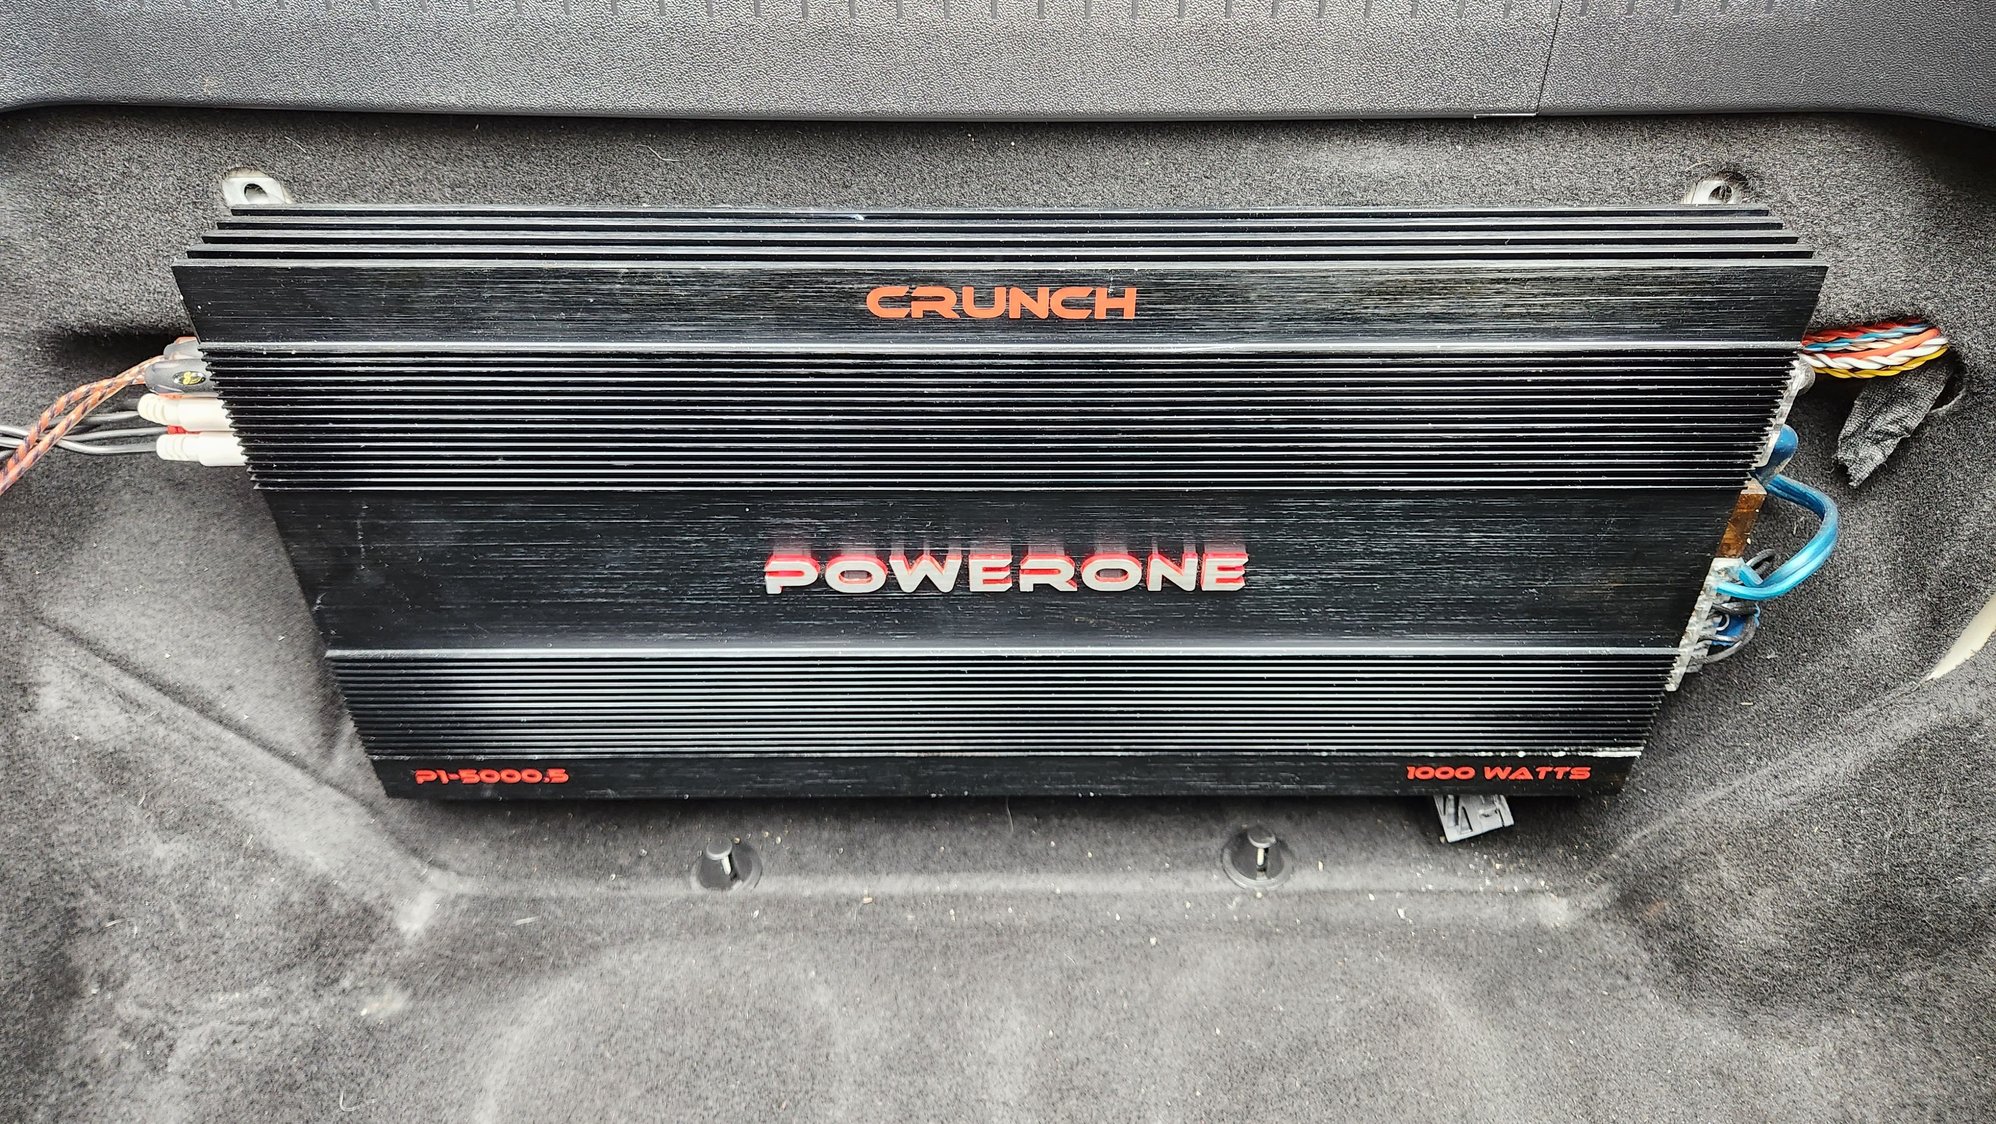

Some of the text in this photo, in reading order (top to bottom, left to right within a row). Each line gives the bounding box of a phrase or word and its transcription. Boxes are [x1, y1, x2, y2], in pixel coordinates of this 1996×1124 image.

[866, 286, 1137, 319] CRUNCH
[765, 552, 1249, 594] POWERONE
[414, 768, 569, 785] P1-5000.5
[1406, 766, 1592, 781] 1000 WATTS
